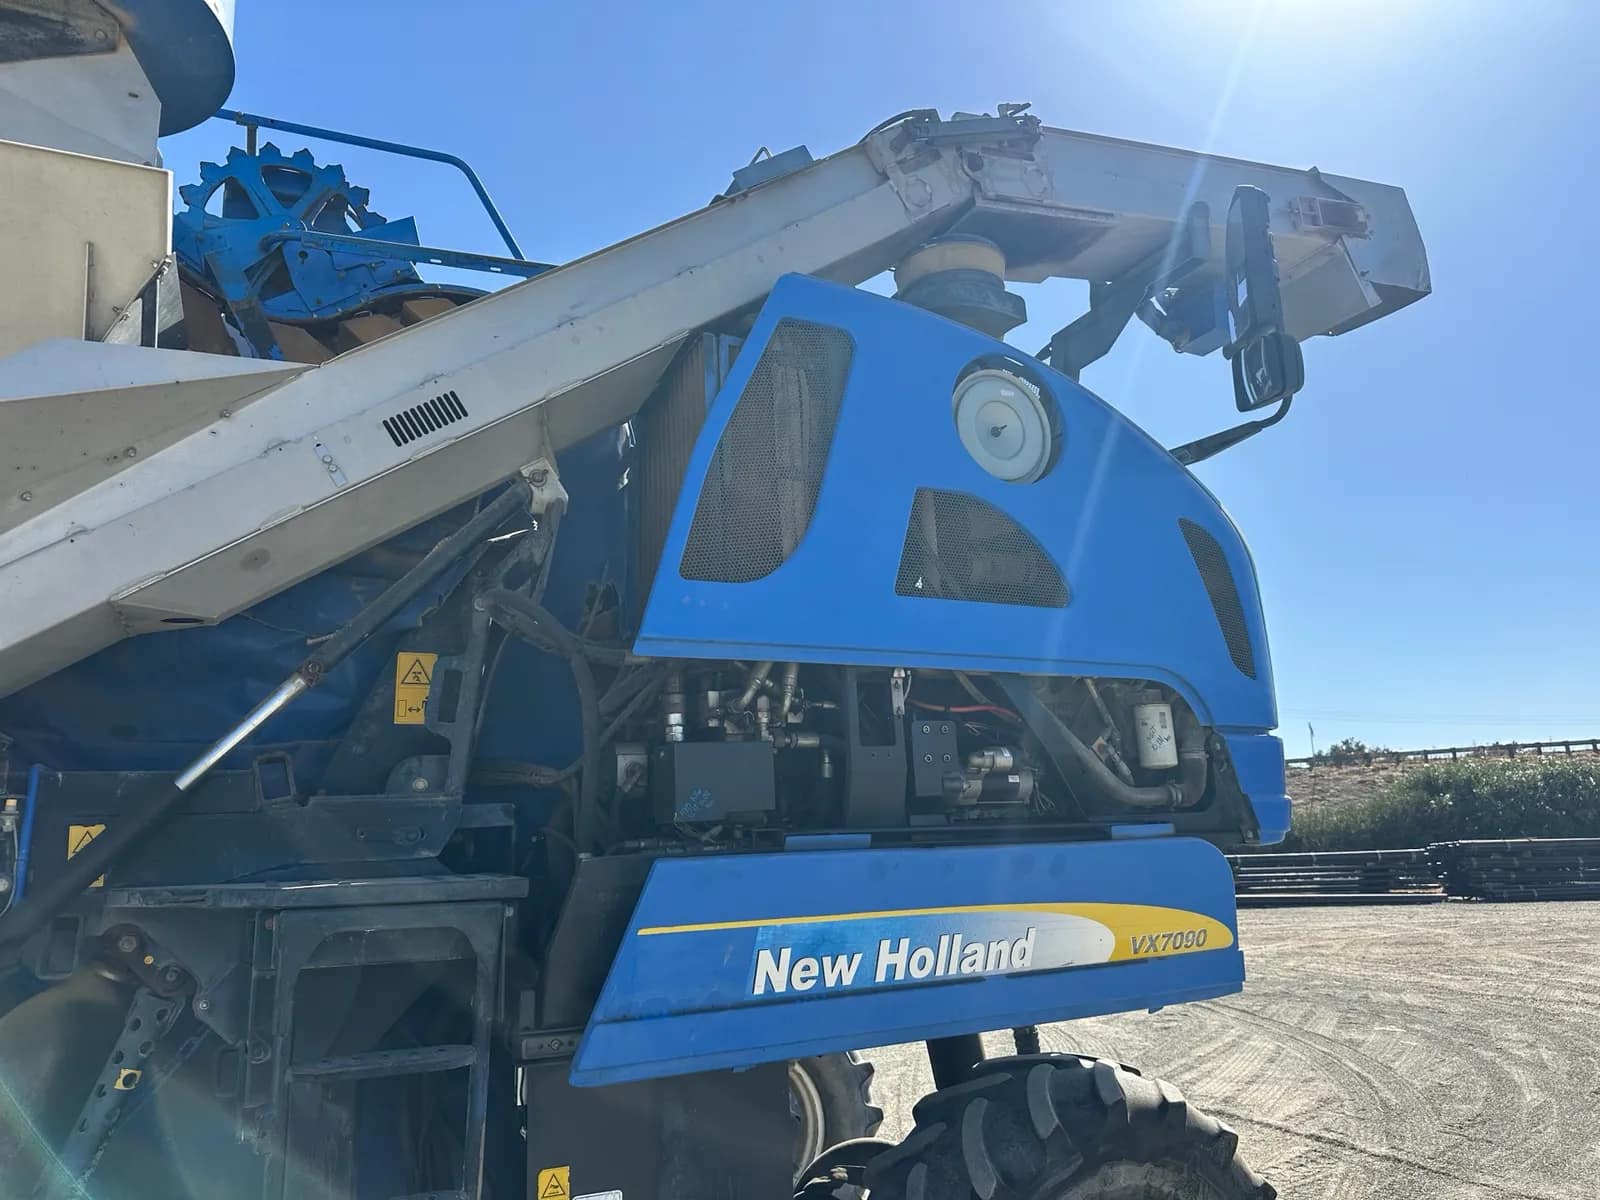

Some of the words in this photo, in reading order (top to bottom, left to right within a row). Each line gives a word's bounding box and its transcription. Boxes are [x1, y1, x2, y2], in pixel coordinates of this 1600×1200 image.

[753, 947, 863, 995] New
[874, 927, 1037, 983] Holland
[1131, 928, 1208, 954] VX7090
